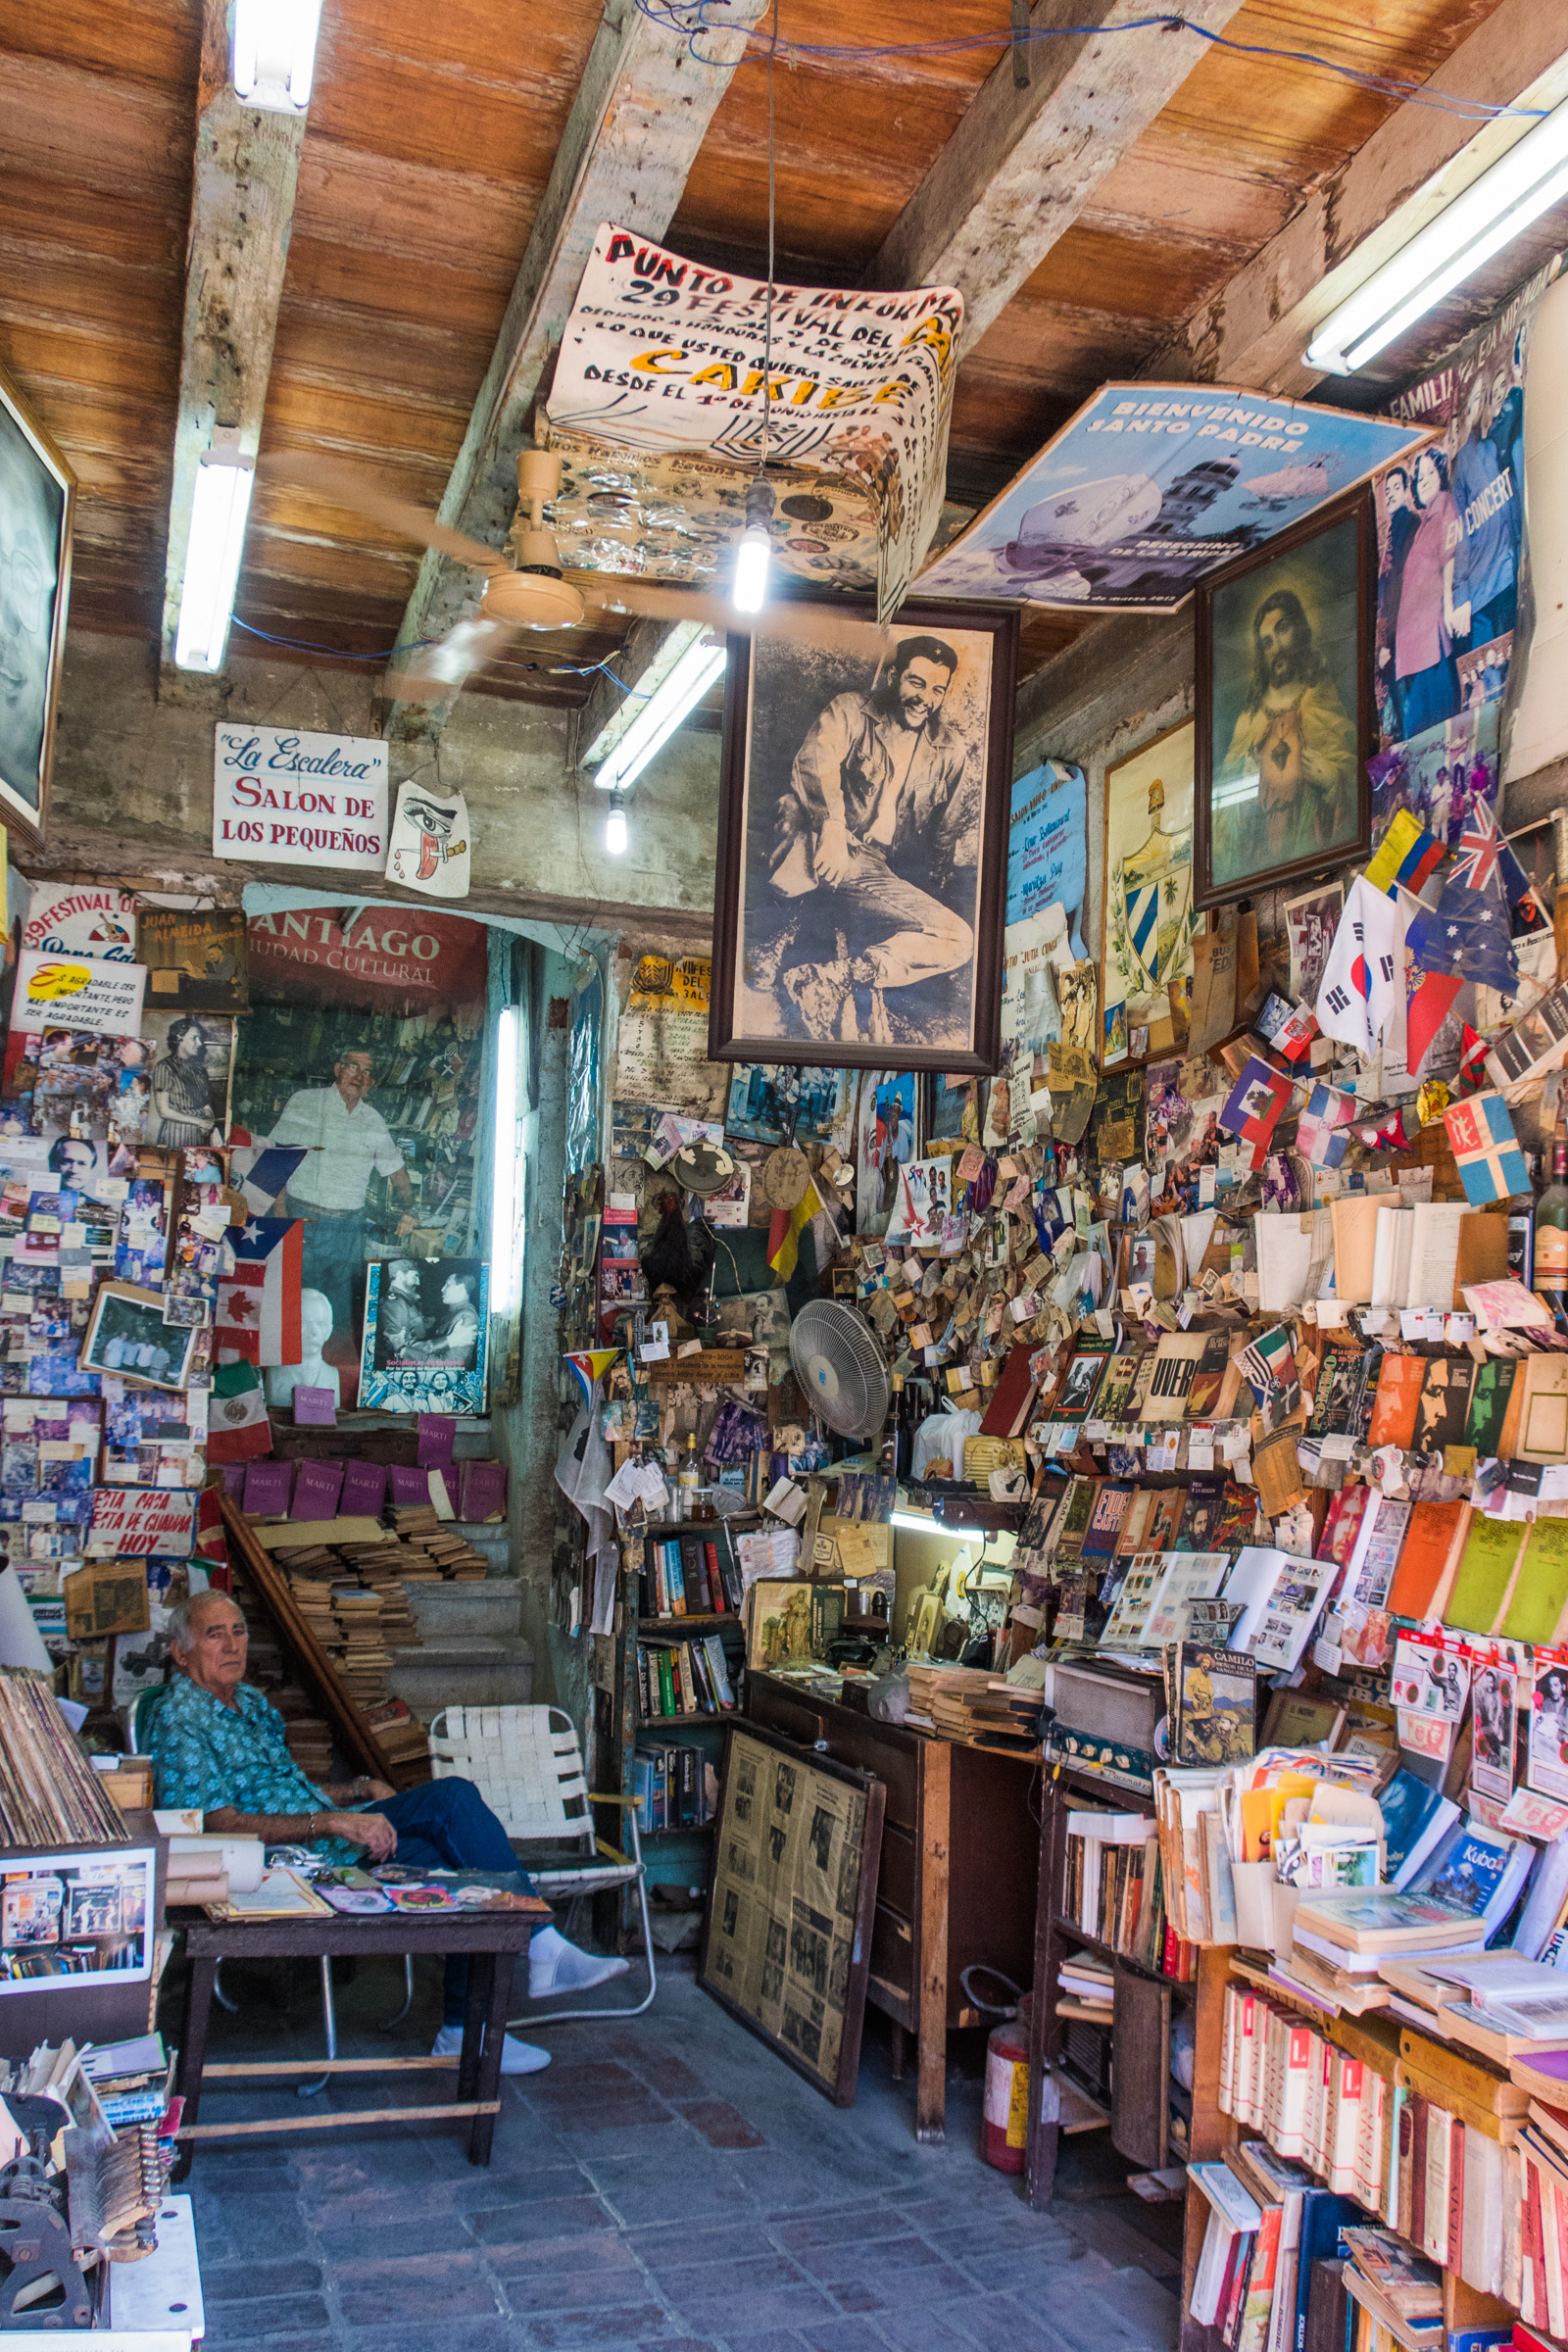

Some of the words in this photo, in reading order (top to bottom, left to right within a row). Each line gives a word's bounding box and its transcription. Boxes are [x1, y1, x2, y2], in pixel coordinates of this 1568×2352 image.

[606, 234, 733, 294] PUNTO
[750, 286, 801, 304] DE
[621, 279, 680, 307] 29
[686, 295, 848, 337] FESTIVAL
[851, 326, 893, 348] DEL
[580, 305, 664, 322] DEDICADO
[686, 320, 783, 345] HONDURAS
[804, 346, 825, 358] LA
[828, 354, 899, 370] CULTURA
[816, 338, 845, 351] DE
[858, 344, 918, 360] JULIO
[595, 321, 626, 332] LO
[629, 327, 676, 344] QUE
[681, 339, 747, 363] USTED
[748, 357, 820, 380] QUIERA
[825, 374, 890, 389] SABER
[896, 373, 921, 391] DE
[584, 365, 658, 392] DESDE
[662, 384, 687, 400] EL
[729, 398, 755, 410] DE
[759, 405, 811, 419] JUNIO
[812, 409, 855, 419] HASTA
[859, 407, 880, 416] EL
[630, 350, 914, 410] CARIBE
[1110, 401, 1309, 436] BIENVENIDO
[1086, 418, 1191, 434] SANTO
[1196, 423, 1303, 454] PADRE
[1445, 512, 1464, 551] EN
[1464, 466, 1514, 538] CONCERT
[1108, 547, 1136, 556] DE
[1137, 548, 1160, 557] LA
[1135, 540, 1241, 550] PEREGRINO
[231, 775, 336, 815] SALON
[344, 797, 375, 819] DE
[220, 818, 265, 843] LOS
[270, 823, 381, 856] PEQUEÑOS
[42, 893, 114, 929] FESTIVAL
[141, 913, 175, 929] JUAN
[154, 921, 213, 941] ALMEIDA
[247, 910, 440, 960] ANTIAGO
[247, 938, 318, 965] IUDAD
[326, 951, 434, 983] CULTURAL
[68, 976, 119, 990] AGRADABLE
[120, 982, 136, 992] SER
[682, 975, 704, 989] DEL
[24, 1008, 42, 1017] SER
[49, 999, 113, 1016] IMPORTANTE
[115, 1009, 129, 1018] ES
[112, 996, 134, 1005] PERO
[94, 1492, 125, 1509] ESTA
[135, 1493, 171, 1510] CASA
[1097, 1489, 1133, 1516] FIDE
[91, 1510, 128, 1531] ESTA
[128, 1514, 144, 1533] DE
[1093, 1513, 1122, 1532] CAST
[1214, 1651, 1254, 1667] CAMILO
[1215, 1667, 1254, 1678] VANGUARDIA
[1103, 1768, 1152, 1793] Pacemaker
[1462, 1844, 1498, 1871] Kuba
